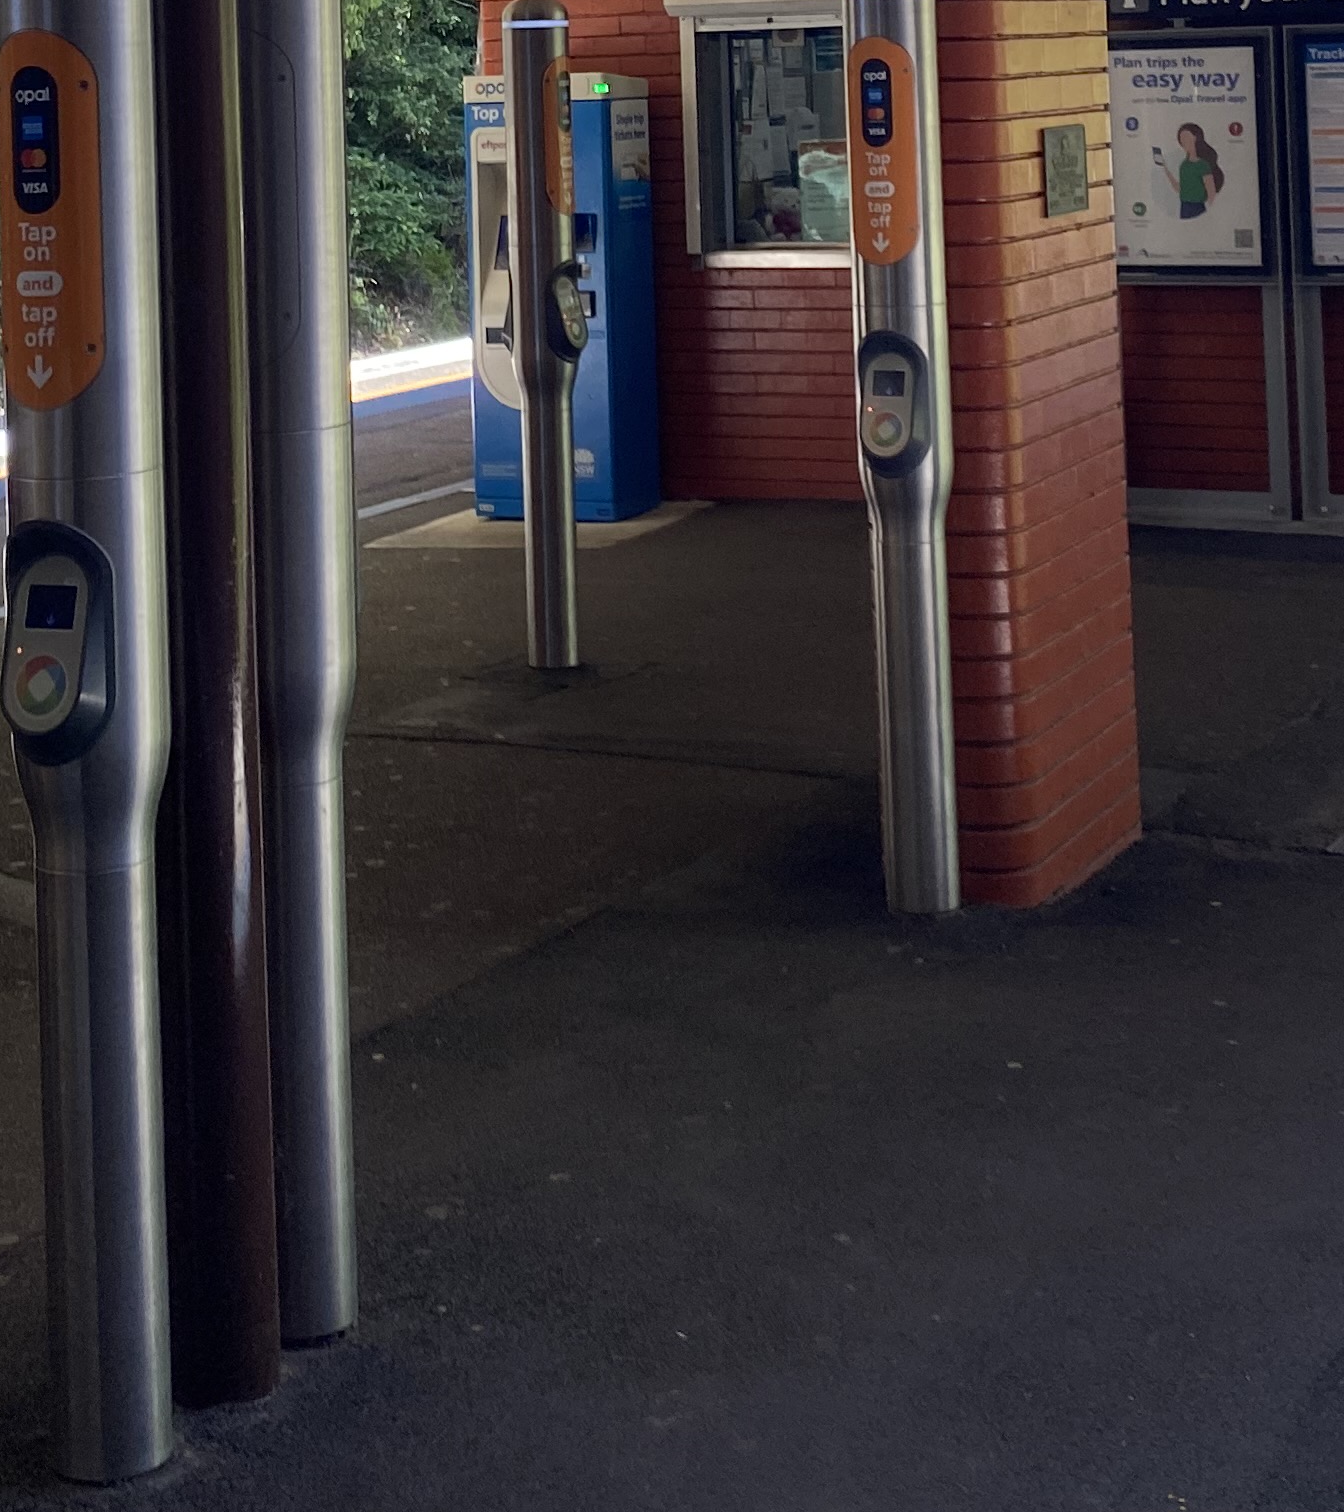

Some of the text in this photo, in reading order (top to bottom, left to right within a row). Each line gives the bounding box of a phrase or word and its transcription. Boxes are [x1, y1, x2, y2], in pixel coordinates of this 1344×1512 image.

[1113, 55, 1205, 70] Plan trips the
[863, 71, 887, 83] opal
[1132, 72, 1241, 92] easy way
[15, 86, 50, 105] opal
[475, 82, 505, 98] opa
[471, 105, 499, 124] Top
[865, 152, 892, 167] Tap
[869, 166, 888, 176] on
[22, 182, 48, 194] VISA
[868, 184, 890, 195] and
[867, 201, 892, 216] tap
[870, 216, 891, 228] off
[18, 222, 57, 245] Tap
[24, 245, 50, 261] on
[22, 275, 53, 291] and
[21, 303, 58, 326] tap
[24, 327, 55, 347] off
